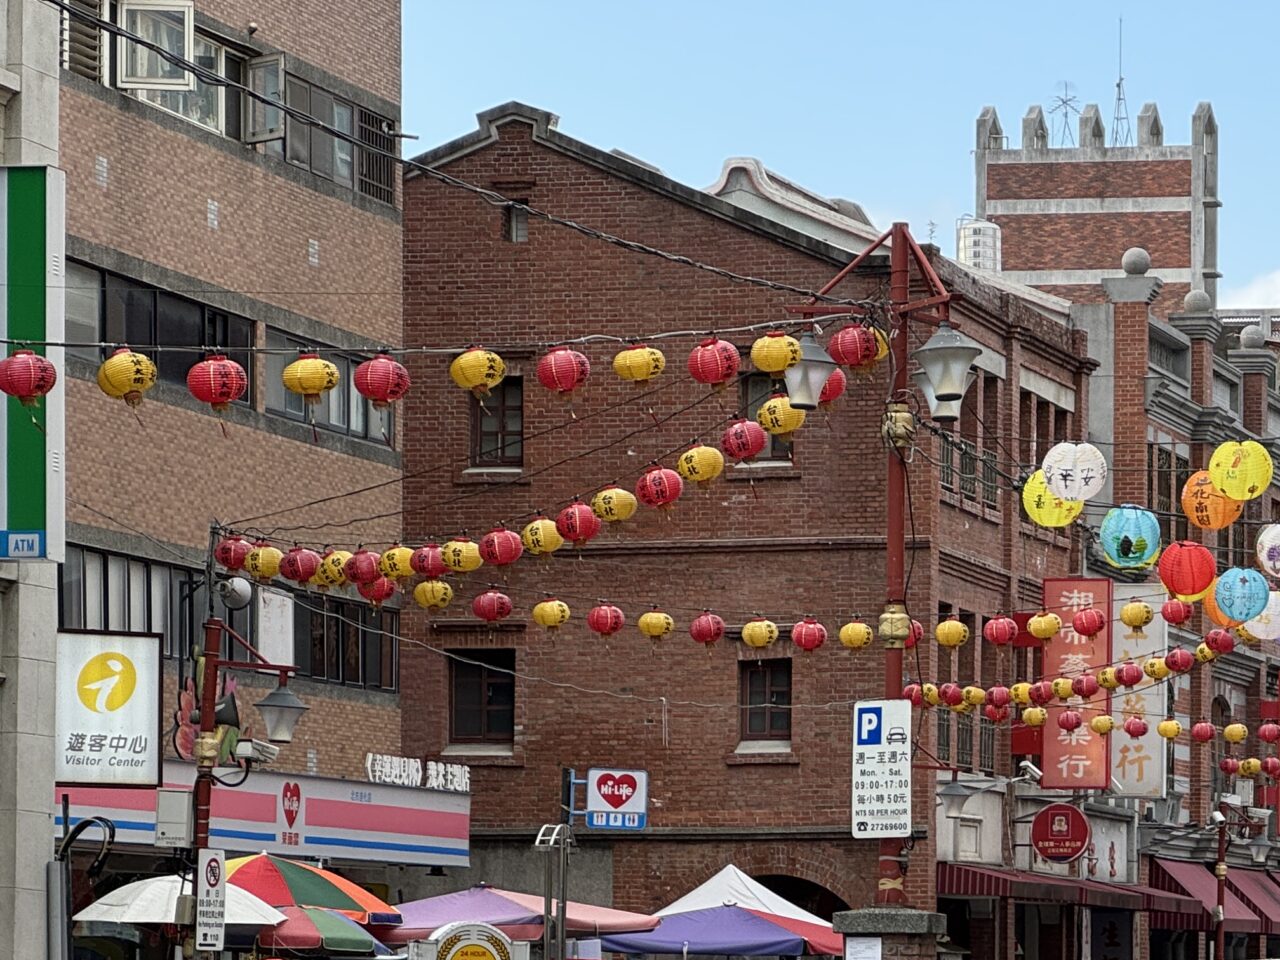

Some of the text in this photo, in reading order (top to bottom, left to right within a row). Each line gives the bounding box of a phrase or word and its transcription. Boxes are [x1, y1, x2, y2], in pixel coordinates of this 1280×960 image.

[767, 404, 782, 428] 台北
[684, 454, 699, 475] 台北
[602, 494, 616, 517] 台北
[13, 537, 35, 553] ATM
[529, 525, 543, 549] 台北
[250, 551, 261, 573] 台北
[387, 552, 400, 573] 台北
[452, 547, 463, 568] 台北
[861, 712, 878, 740] P
[65, 732, 147, 754] 遊客中心
[65, 755, 146, 768] Visitor Center
[855, 750, 908, 765] 週一至週六
[860, 768, 877, 777] Mon.
[888, 767, 903, 776] Sat.
[600, 780, 633, 800] Hi-Life
[854, 779, 909, 790] 09:00-17:00
[868, 809, 875, 817] 50
[876, 808, 888, 817] PER
[890, 807, 908, 816] HOUR
[870, 821, 908, 831] 27269600
